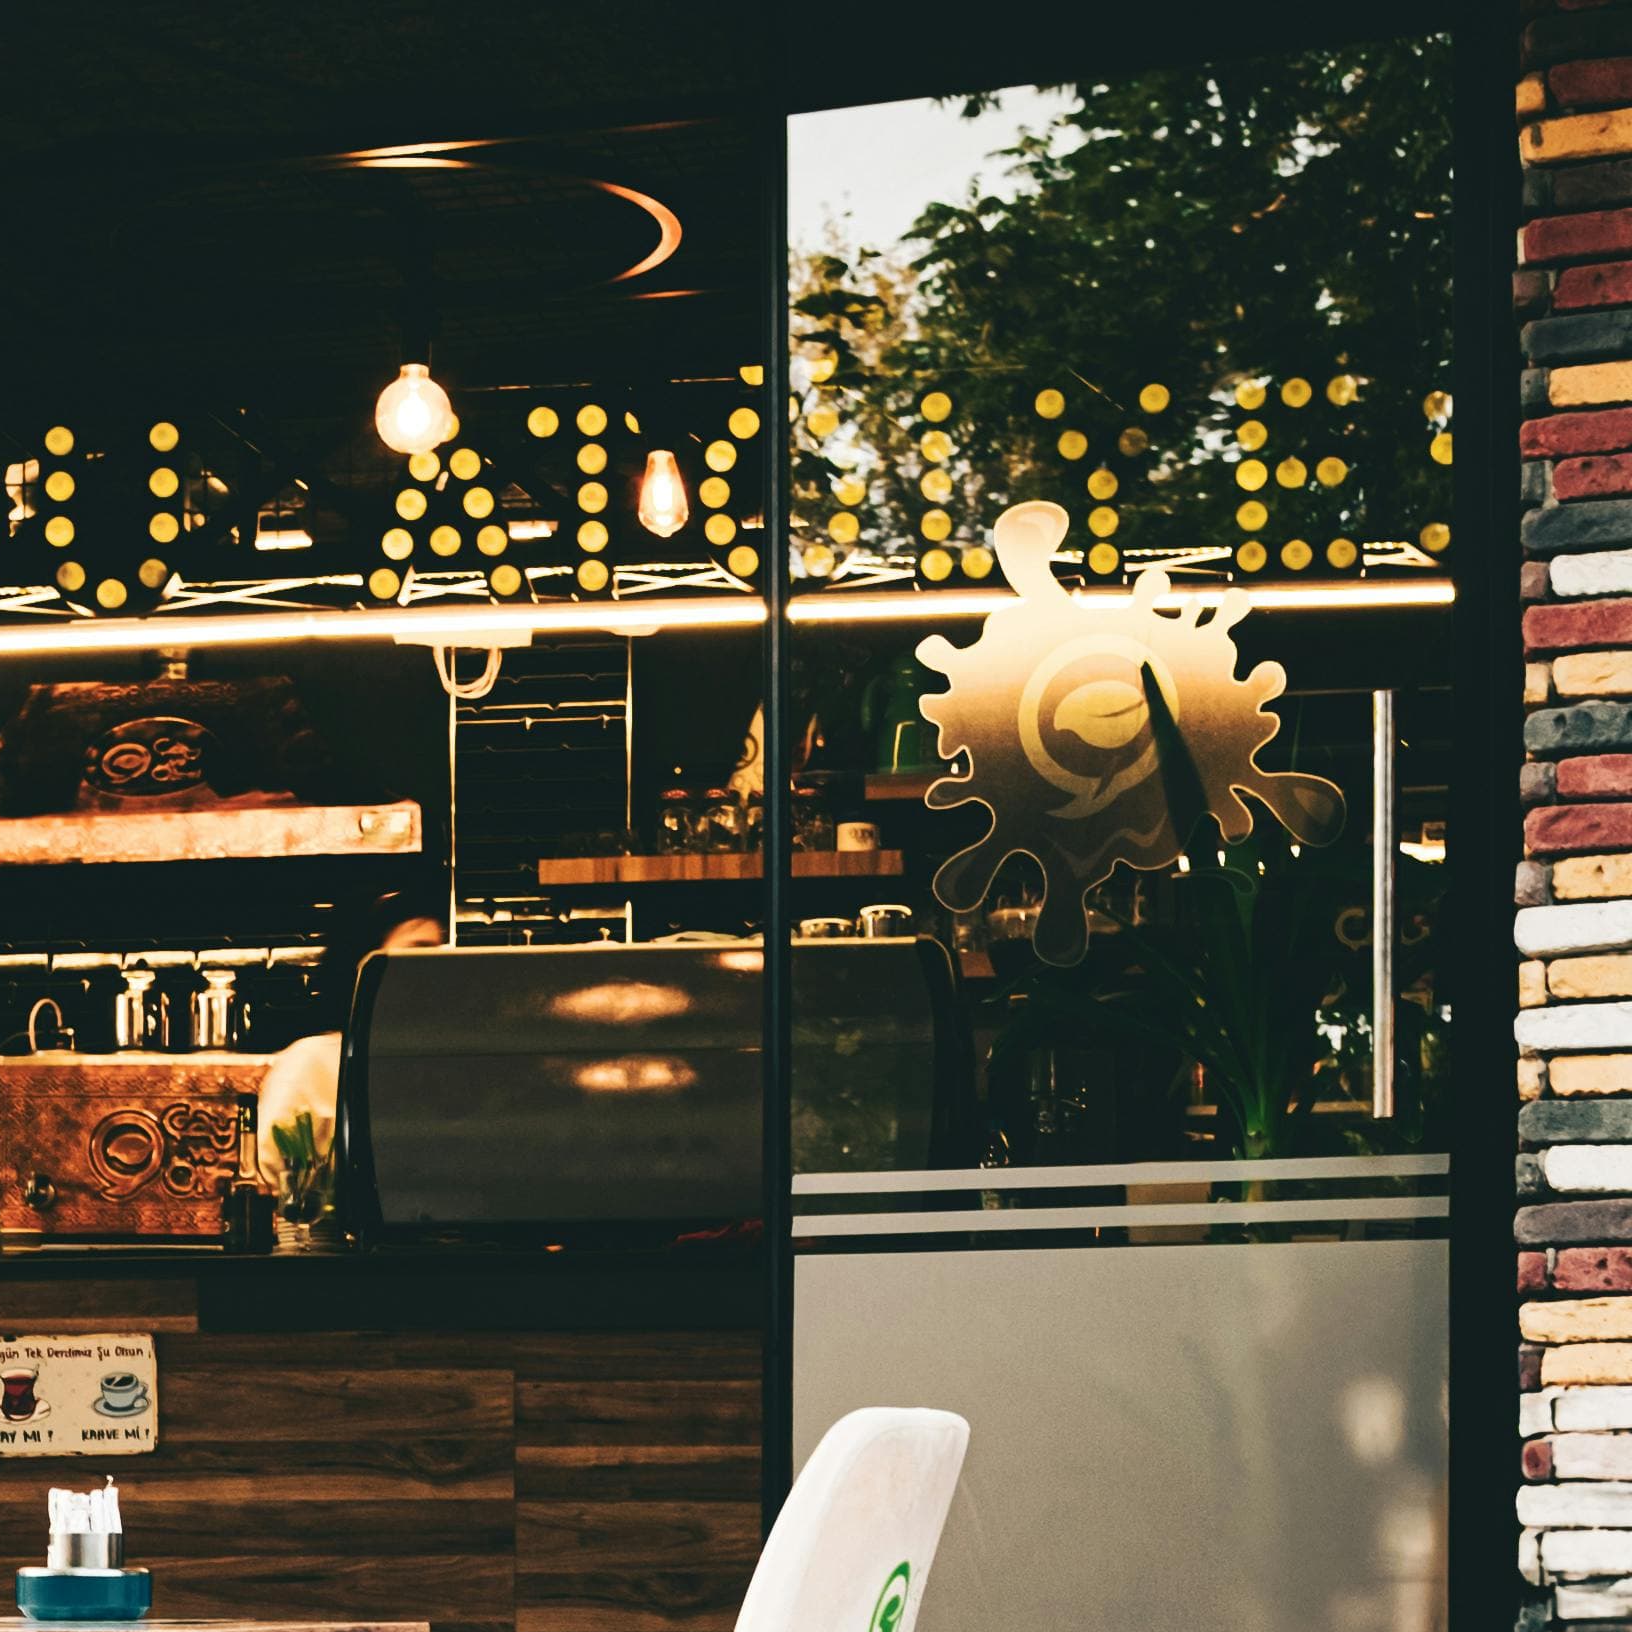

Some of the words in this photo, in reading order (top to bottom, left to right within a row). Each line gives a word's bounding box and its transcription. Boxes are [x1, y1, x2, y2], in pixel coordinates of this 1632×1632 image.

[24, 1346, 43, 1359] Tek
[96, 1346, 111, 1361] Şu
[23, 1429, 42, 1443] MI
[81, 1428, 120, 1441] KAHVE
